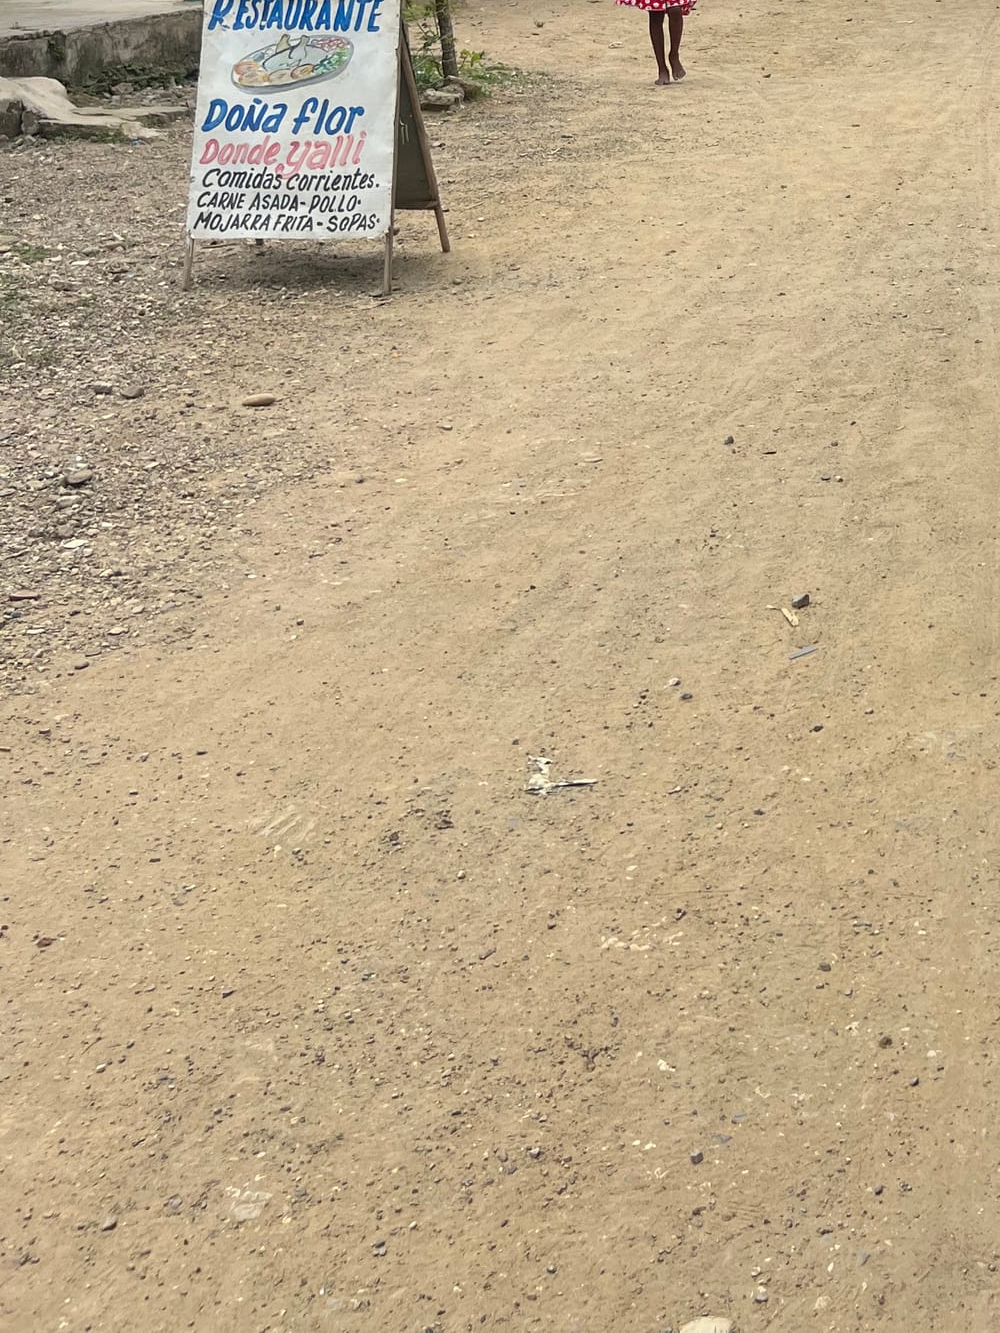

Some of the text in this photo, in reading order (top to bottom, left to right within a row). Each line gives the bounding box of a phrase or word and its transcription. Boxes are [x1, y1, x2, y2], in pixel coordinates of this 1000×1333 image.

[292, 97, 365, 135] flor
[199, 135, 281, 165] Donde
[202, 166, 283, 190] Comidas
[197, 191, 246, 210] CARNE
[193, 211, 271, 232] MOJARRA
[272, 214, 313, 232] FRITA
